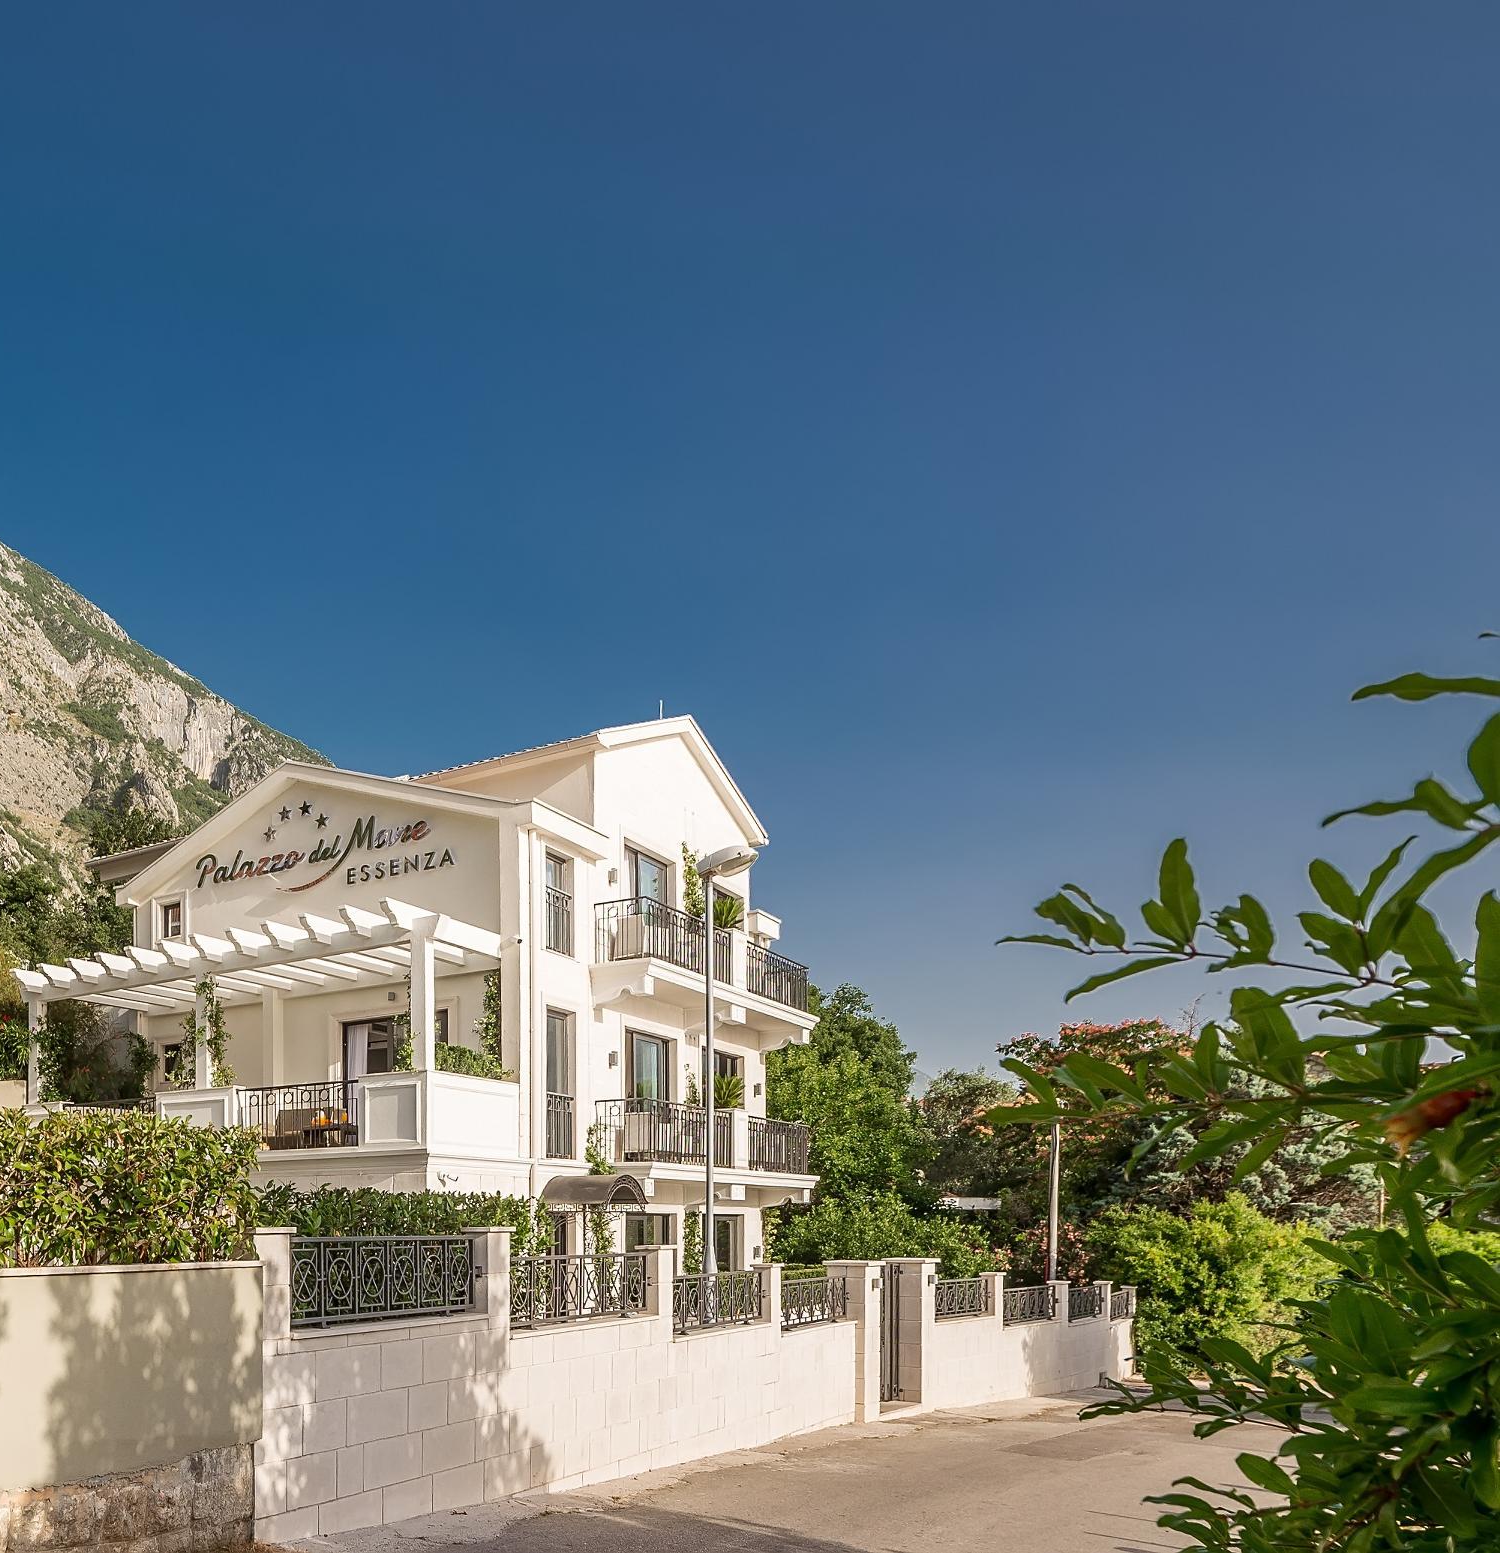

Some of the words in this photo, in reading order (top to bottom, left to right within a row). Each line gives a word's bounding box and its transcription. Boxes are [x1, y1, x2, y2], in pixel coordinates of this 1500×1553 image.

[196, 849, 306, 889] Palazzo
[308, 834, 342, 864] del
[346, 848, 455, 886] ESSENZA
